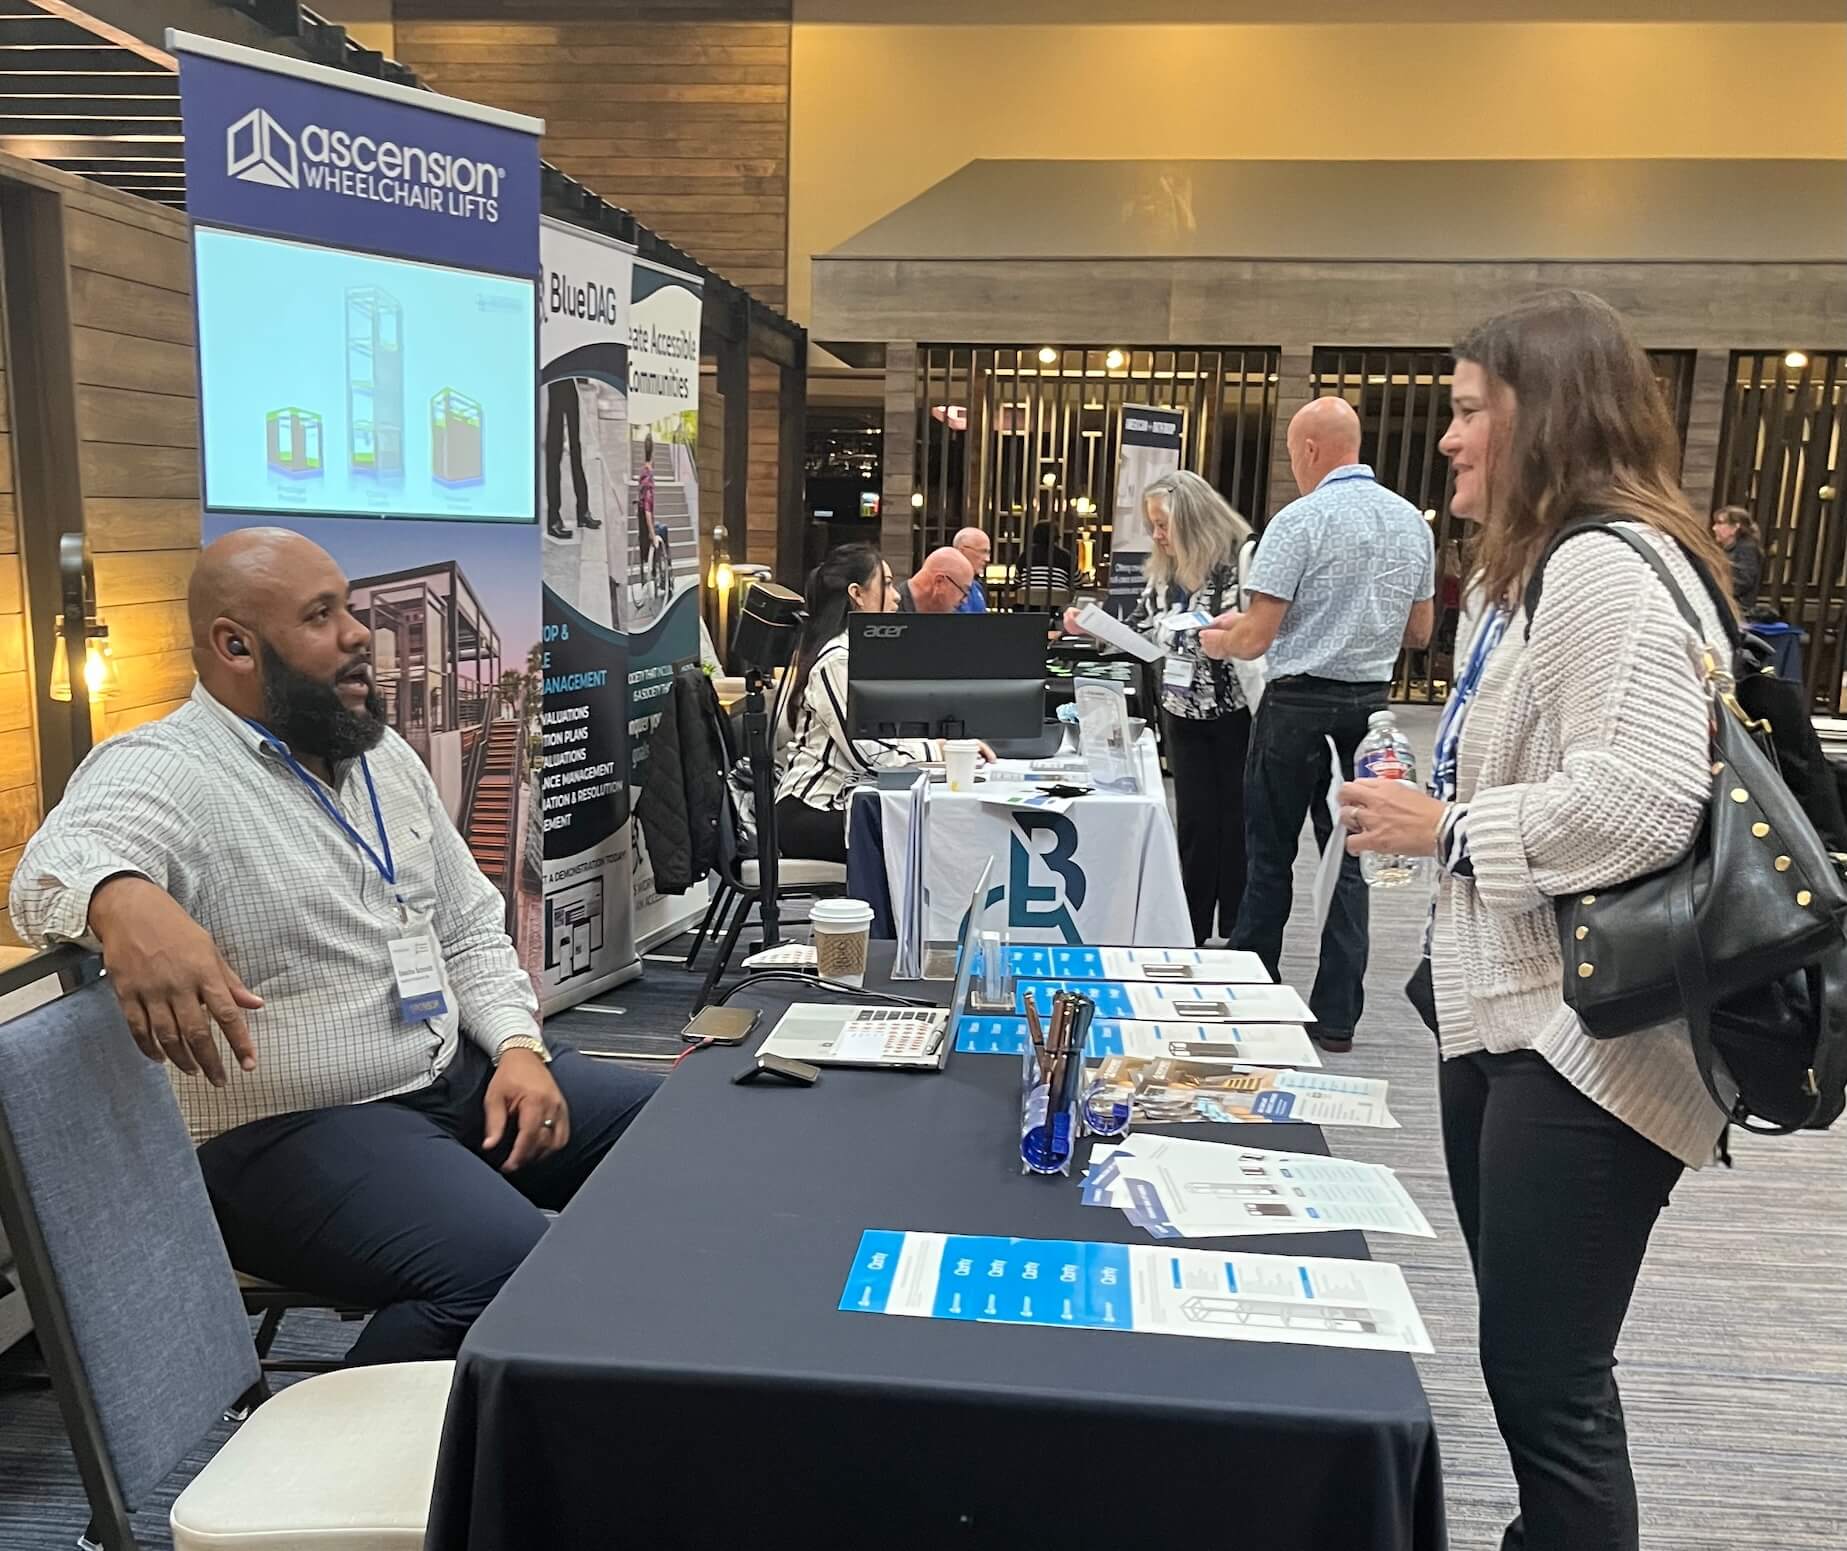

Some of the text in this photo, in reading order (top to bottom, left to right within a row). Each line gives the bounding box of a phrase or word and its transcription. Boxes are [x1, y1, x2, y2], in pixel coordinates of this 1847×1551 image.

[303, 161, 499, 222] WHEELCHAIR LIFTS
[551, 272, 616, 325] BlueDAG
[651, 323, 697, 361] Accessible
[561, 623, 569, 641] &
[863, 624, 909, 638] acer
[564, 726, 589, 743] PLANS
[562, 761, 615, 787] MANAGEMENT
[578, 780, 624, 803] RESOLUTION
